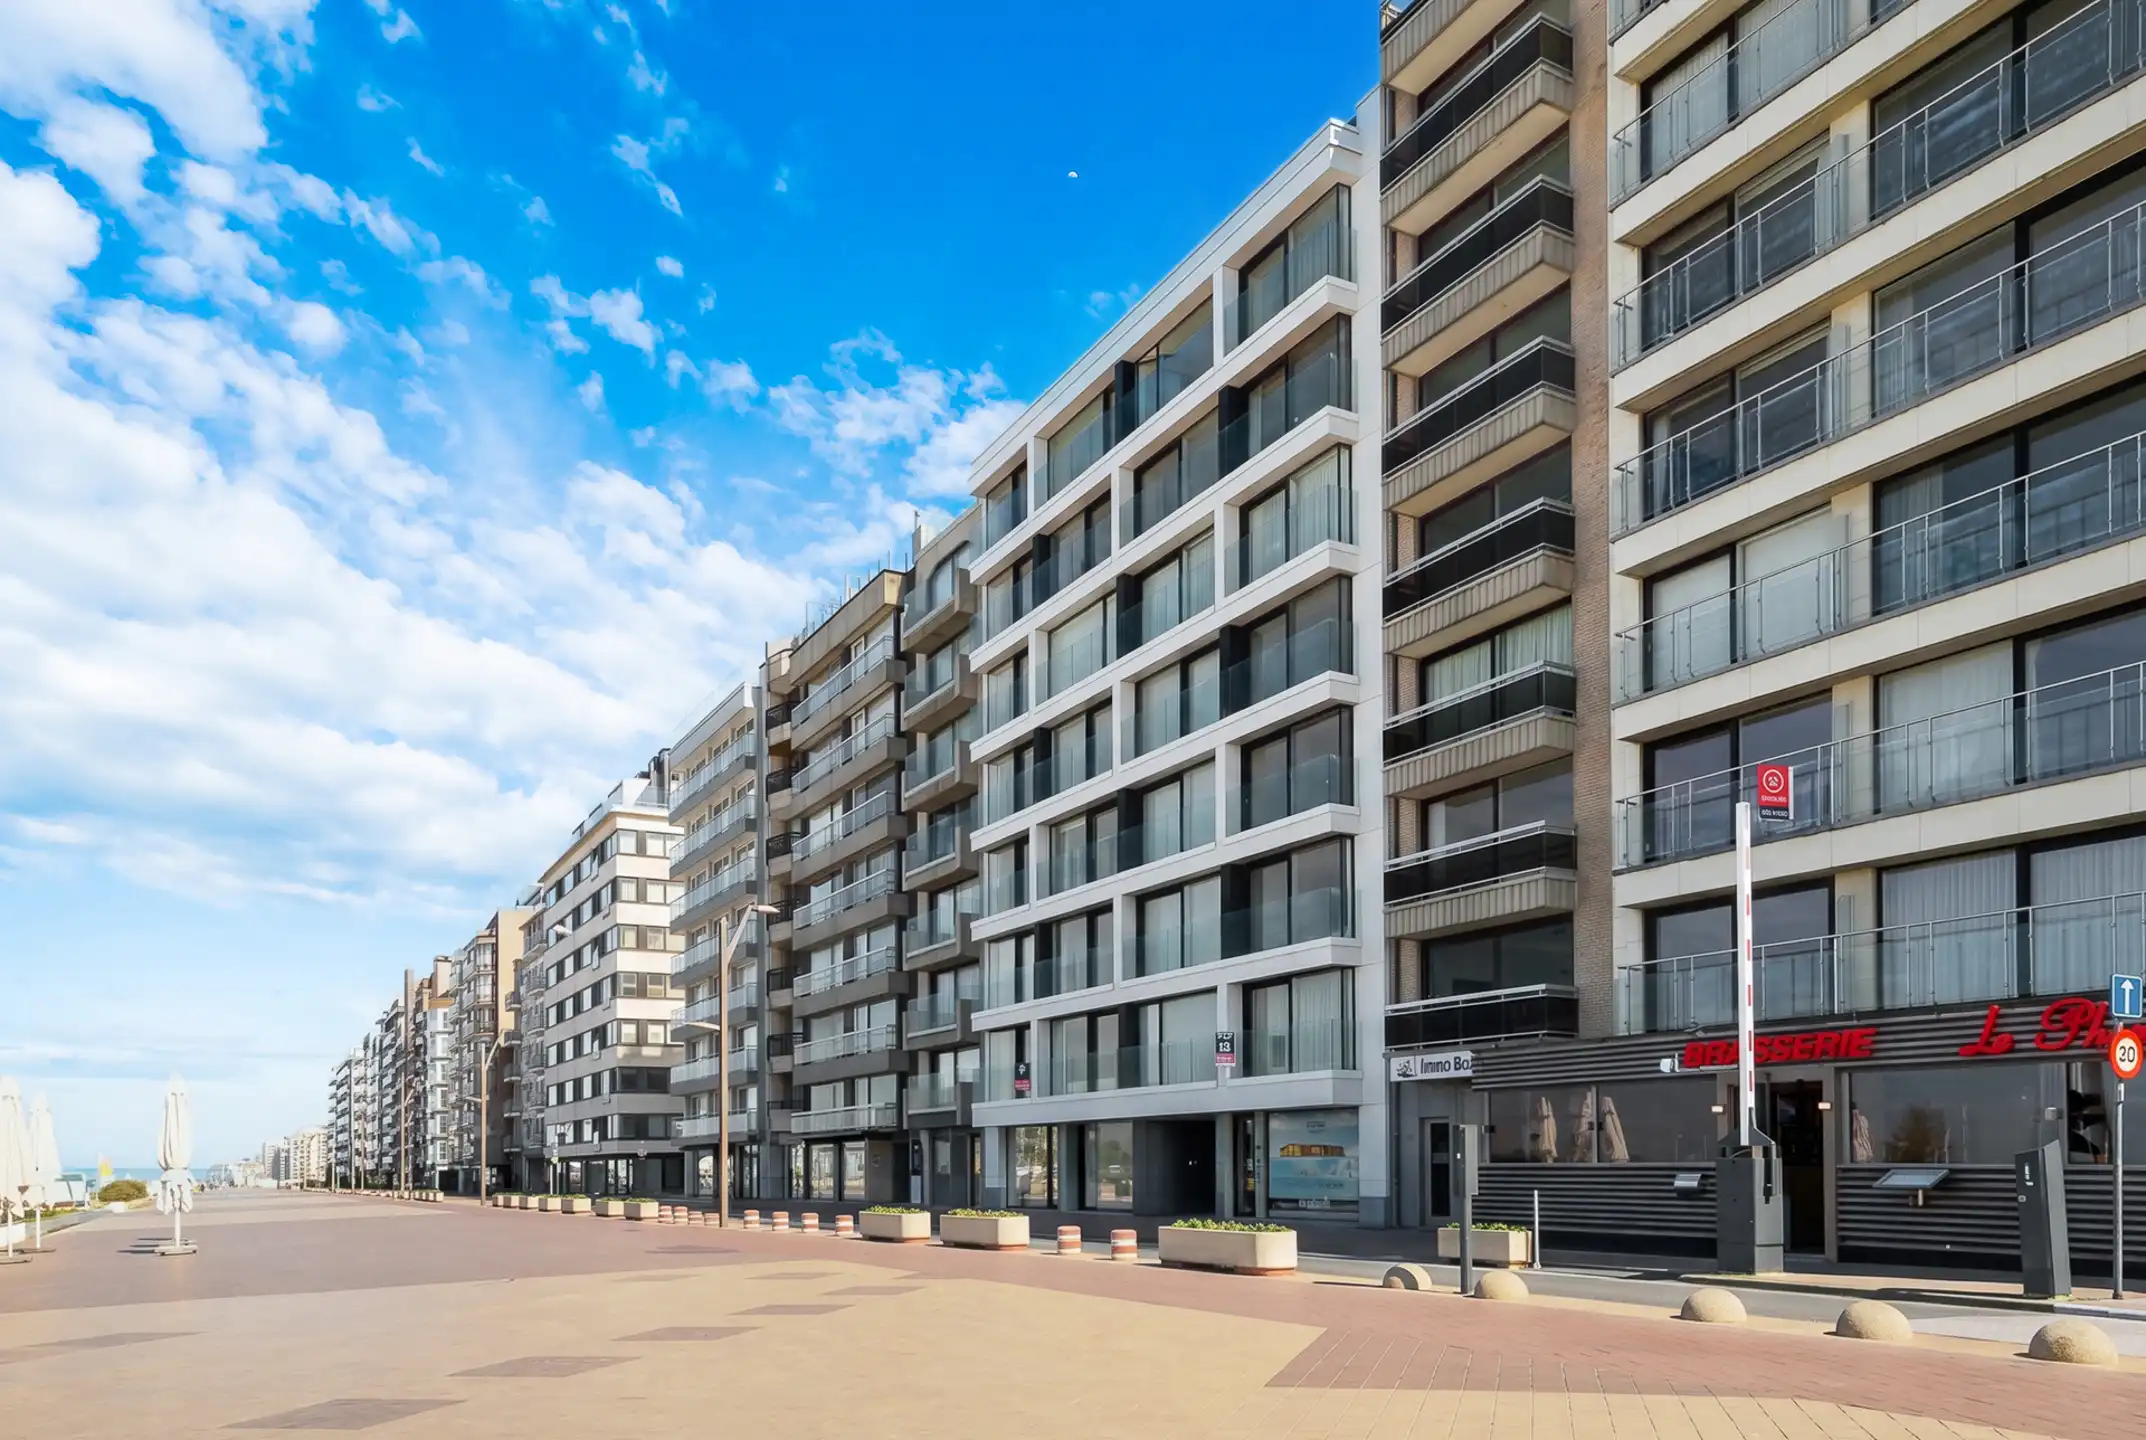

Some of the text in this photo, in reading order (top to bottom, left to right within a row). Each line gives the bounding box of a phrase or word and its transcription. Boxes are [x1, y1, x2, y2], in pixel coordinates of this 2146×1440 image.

[1958, 1004, 2015, 1057] Le
[2118, 1045, 2136, 1062] 30
[1453, 1056, 1473, 1071] Bo
